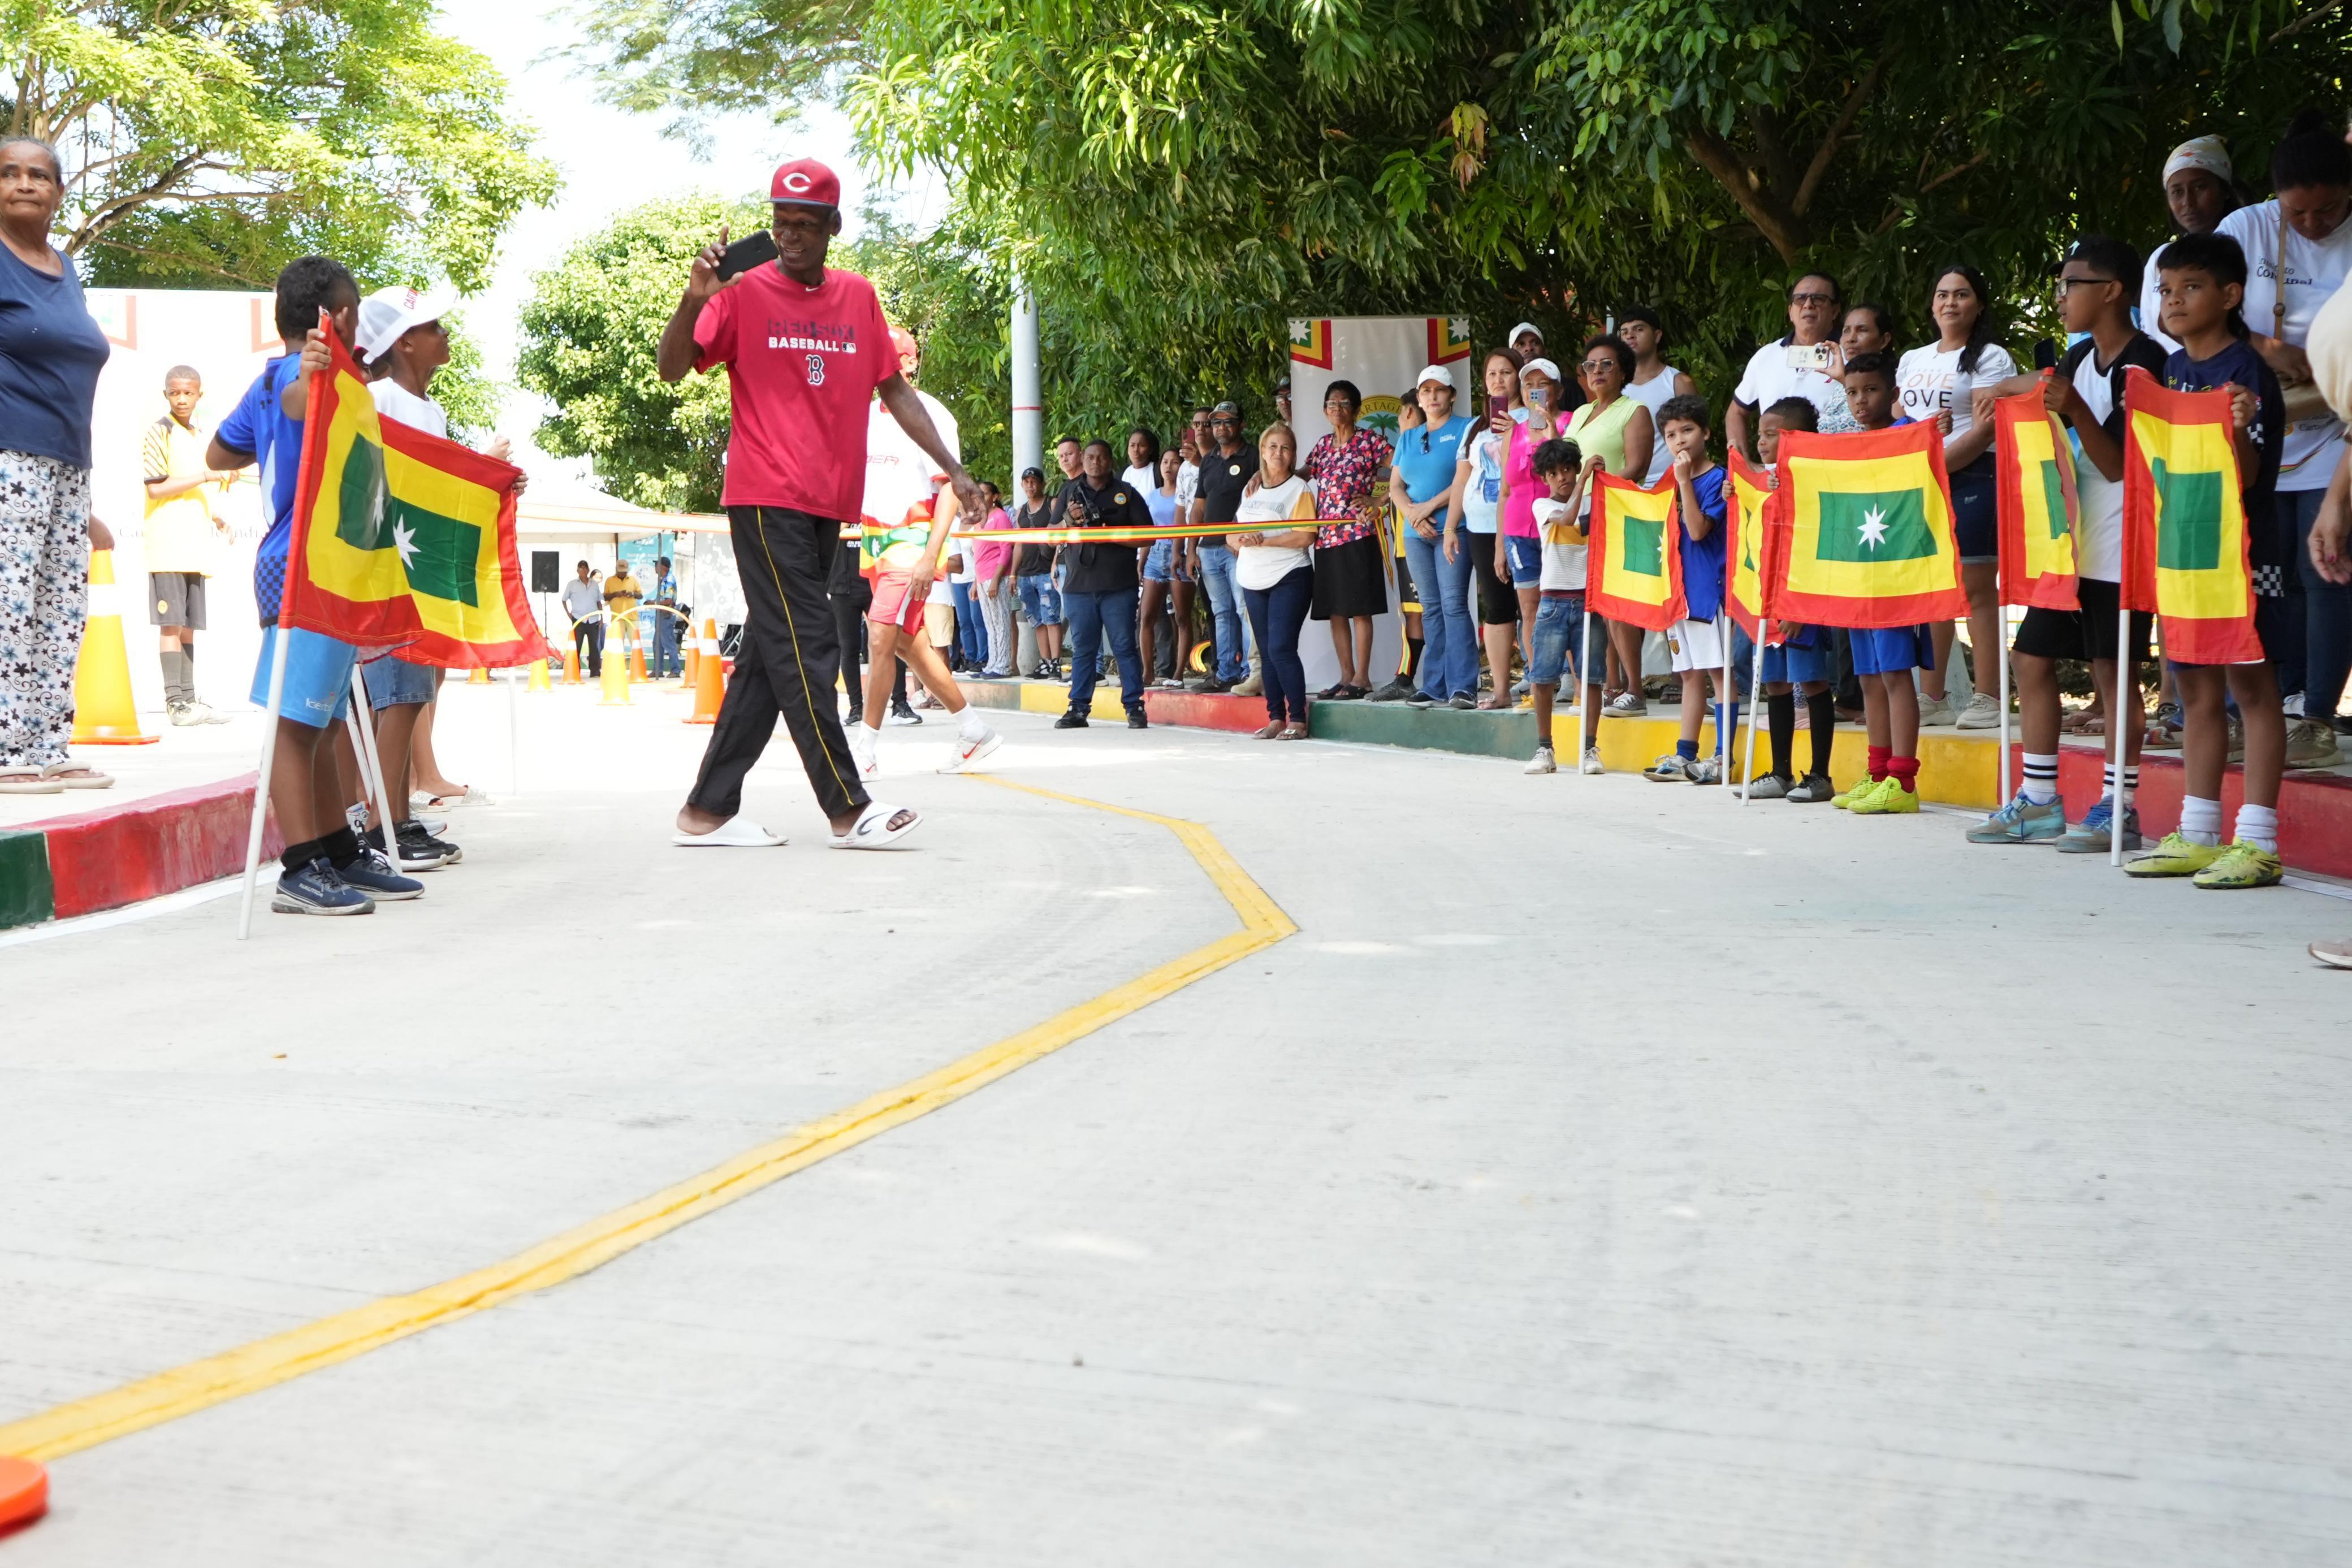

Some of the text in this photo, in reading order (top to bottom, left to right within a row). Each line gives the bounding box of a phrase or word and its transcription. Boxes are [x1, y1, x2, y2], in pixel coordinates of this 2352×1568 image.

[782, 172, 811, 192] C
[768, 337, 839, 352] BASEBALL
[805, 354, 825, 385] B
[1907, 373, 1956, 389] OVE
[1902, 389, 1952, 409] OVE
